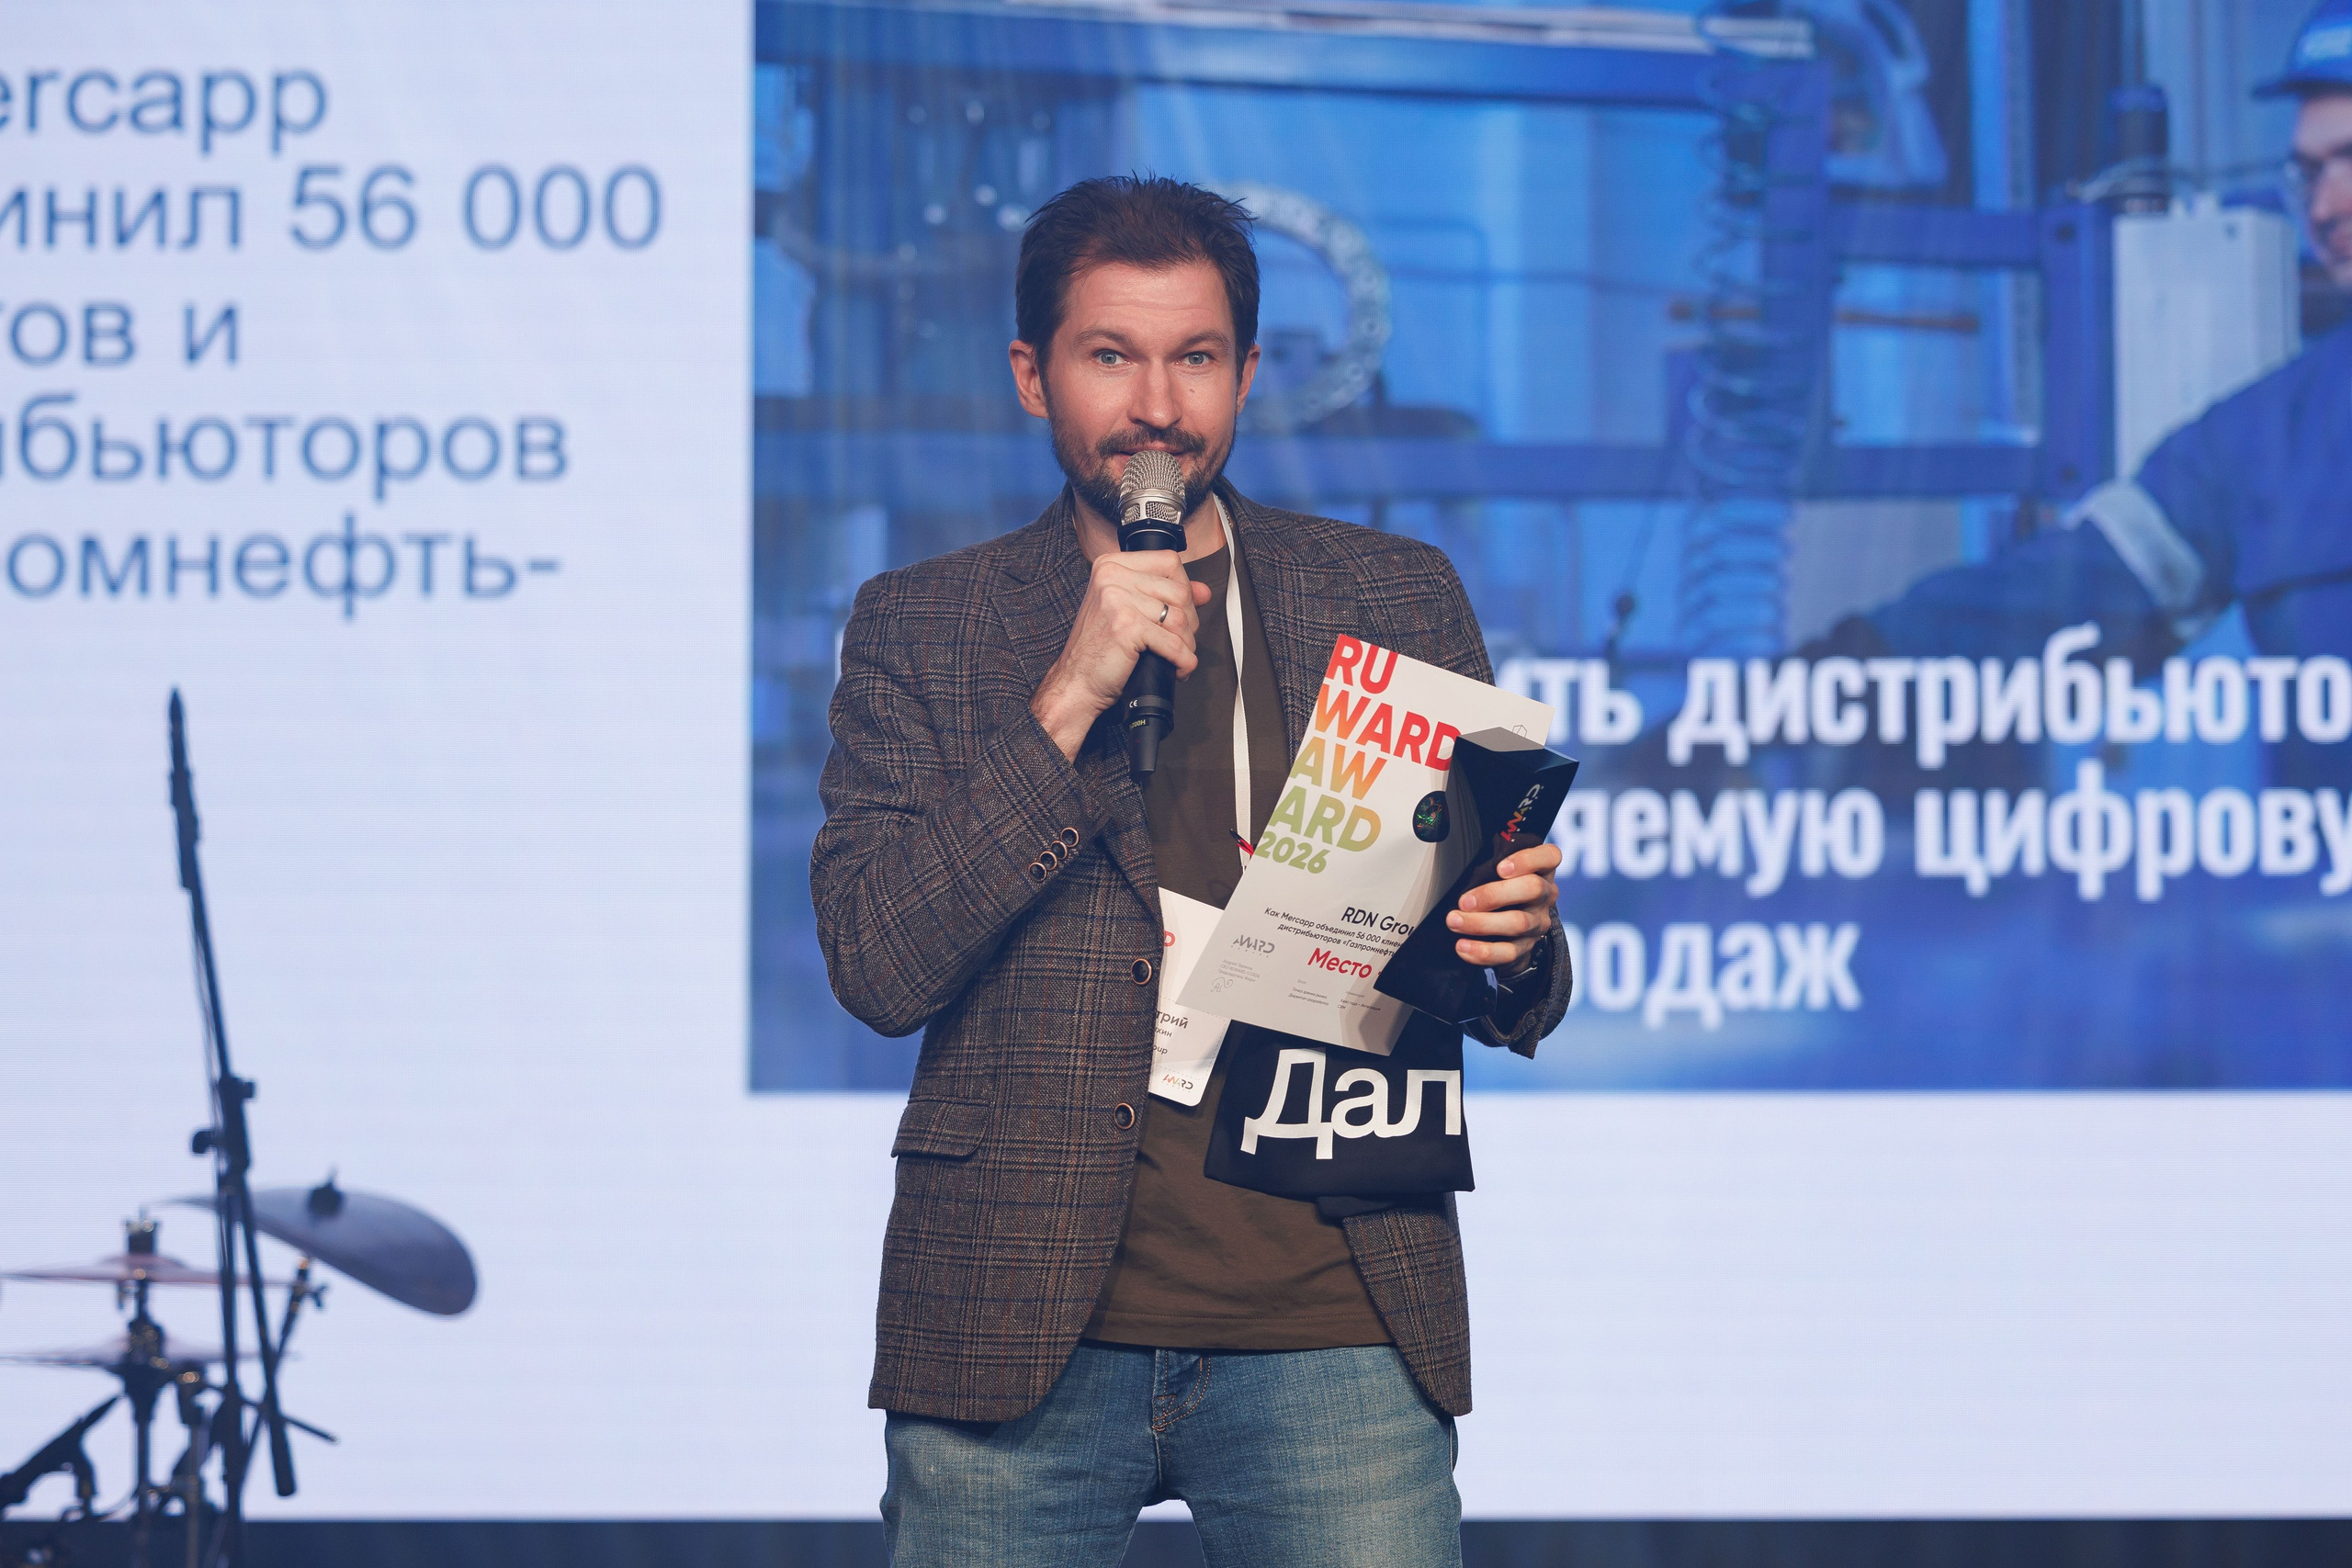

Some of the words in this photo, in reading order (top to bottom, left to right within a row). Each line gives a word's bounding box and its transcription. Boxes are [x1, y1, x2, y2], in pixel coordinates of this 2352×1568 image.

[0, 70, 327, 155] rcapp
[289, 164, 420, 253] 56
[462, 164, 663, 253] 000
[0, 301, 136, 366] ов
[184, 302, 240, 366] и
[0, 391, 568, 505] бьюторов
[1325, 633, 1399, 694] RU
[1315, 683, 1462, 772] WARD
[1288, 736, 1388, 801] AW
[1268, 784, 1382, 852] ARD
[1254, 830, 1331, 874] 2026
[1264, 907, 1280, 918] Как
[1281, 911, 1315, 929] Mercapp
[1316, 923, 1355, 938] объединил
[1356, 931, 1366, 940] 56
[1365, 933, 1381, 943] 000
[1277, 923, 1341, 944] дистрибьюторов
[1340, 906, 1379, 928] RDN
[1307, 947, 1373, 979] Место
[1240, 1047, 1462, 1160] Дал
